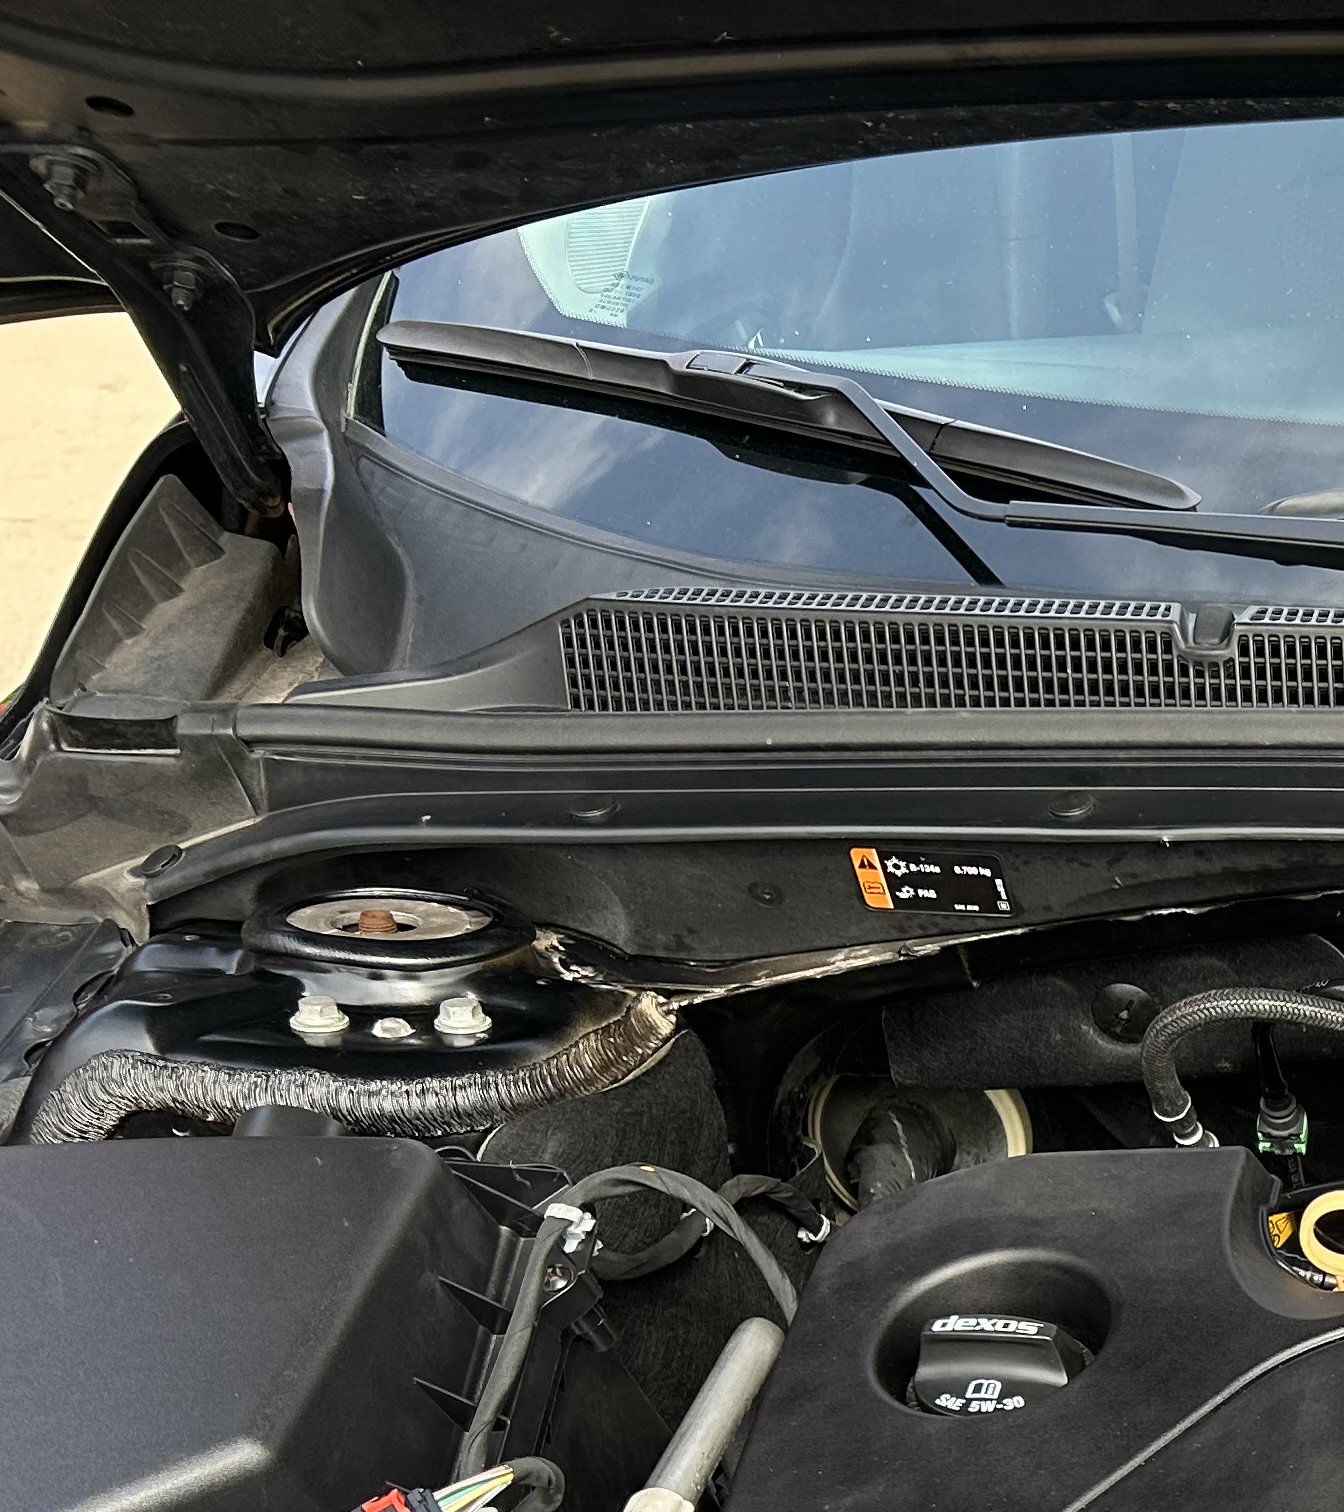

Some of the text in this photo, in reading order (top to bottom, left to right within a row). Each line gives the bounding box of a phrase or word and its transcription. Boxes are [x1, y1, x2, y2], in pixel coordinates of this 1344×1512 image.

[930, 1314, 1044, 1336] dexos
[934, 1393, 1026, 1413] SAE 5W-30
